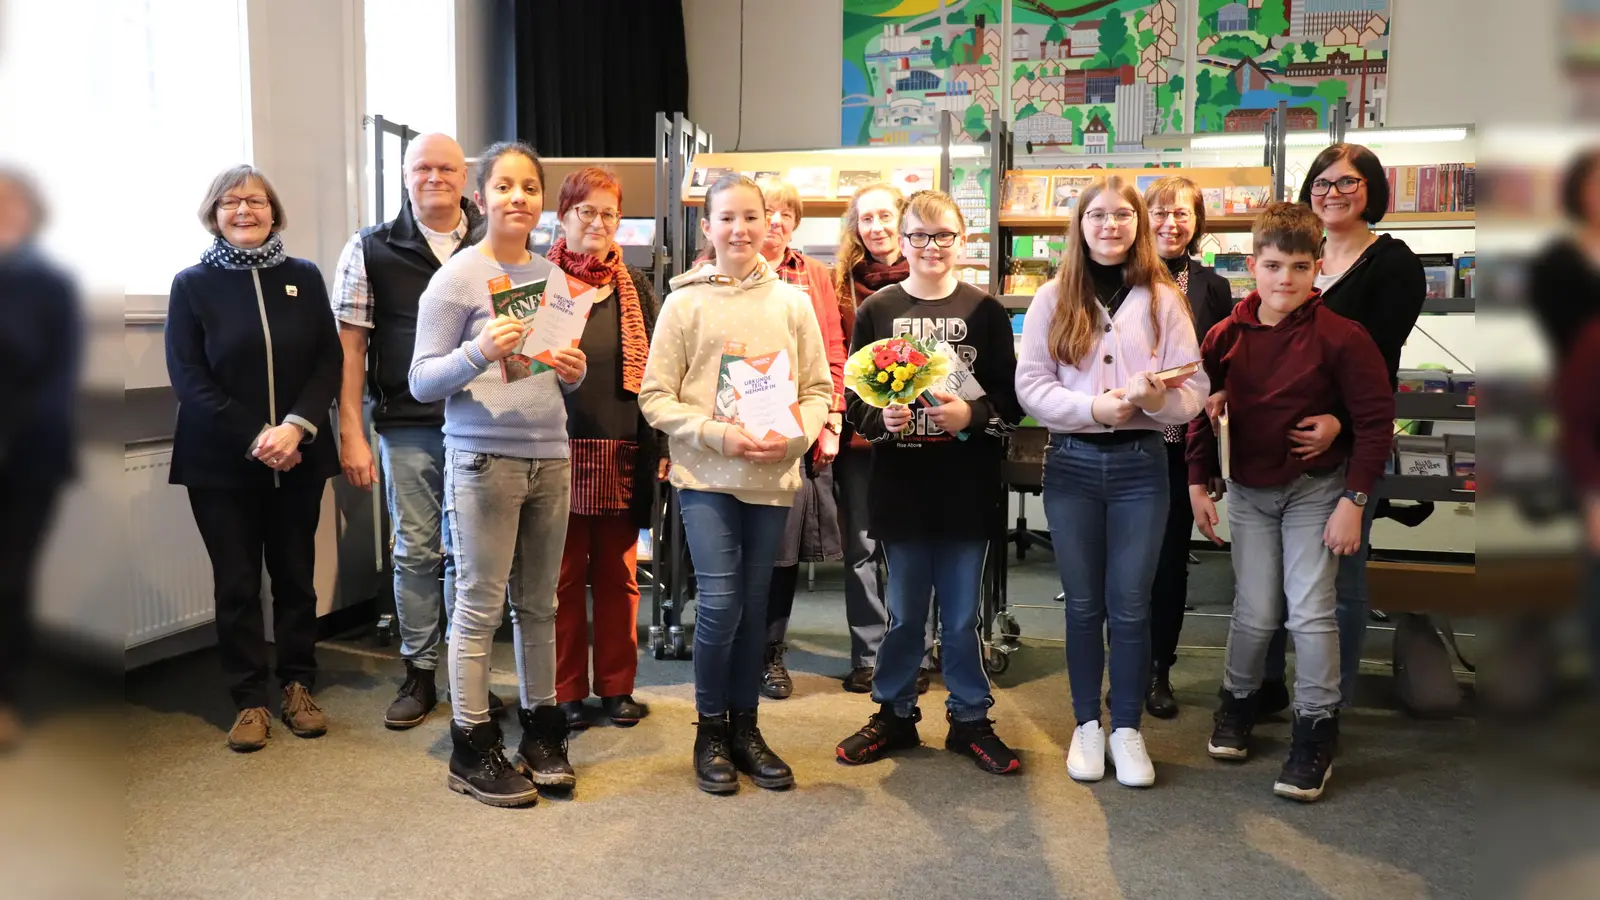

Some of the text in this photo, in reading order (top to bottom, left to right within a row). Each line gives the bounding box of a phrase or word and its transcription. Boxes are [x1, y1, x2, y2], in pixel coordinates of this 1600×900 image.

[553, 293, 576, 306] URKUNDE
[893, 317, 968, 342] FIND
[744, 375, 771, 386] URKUNDE
